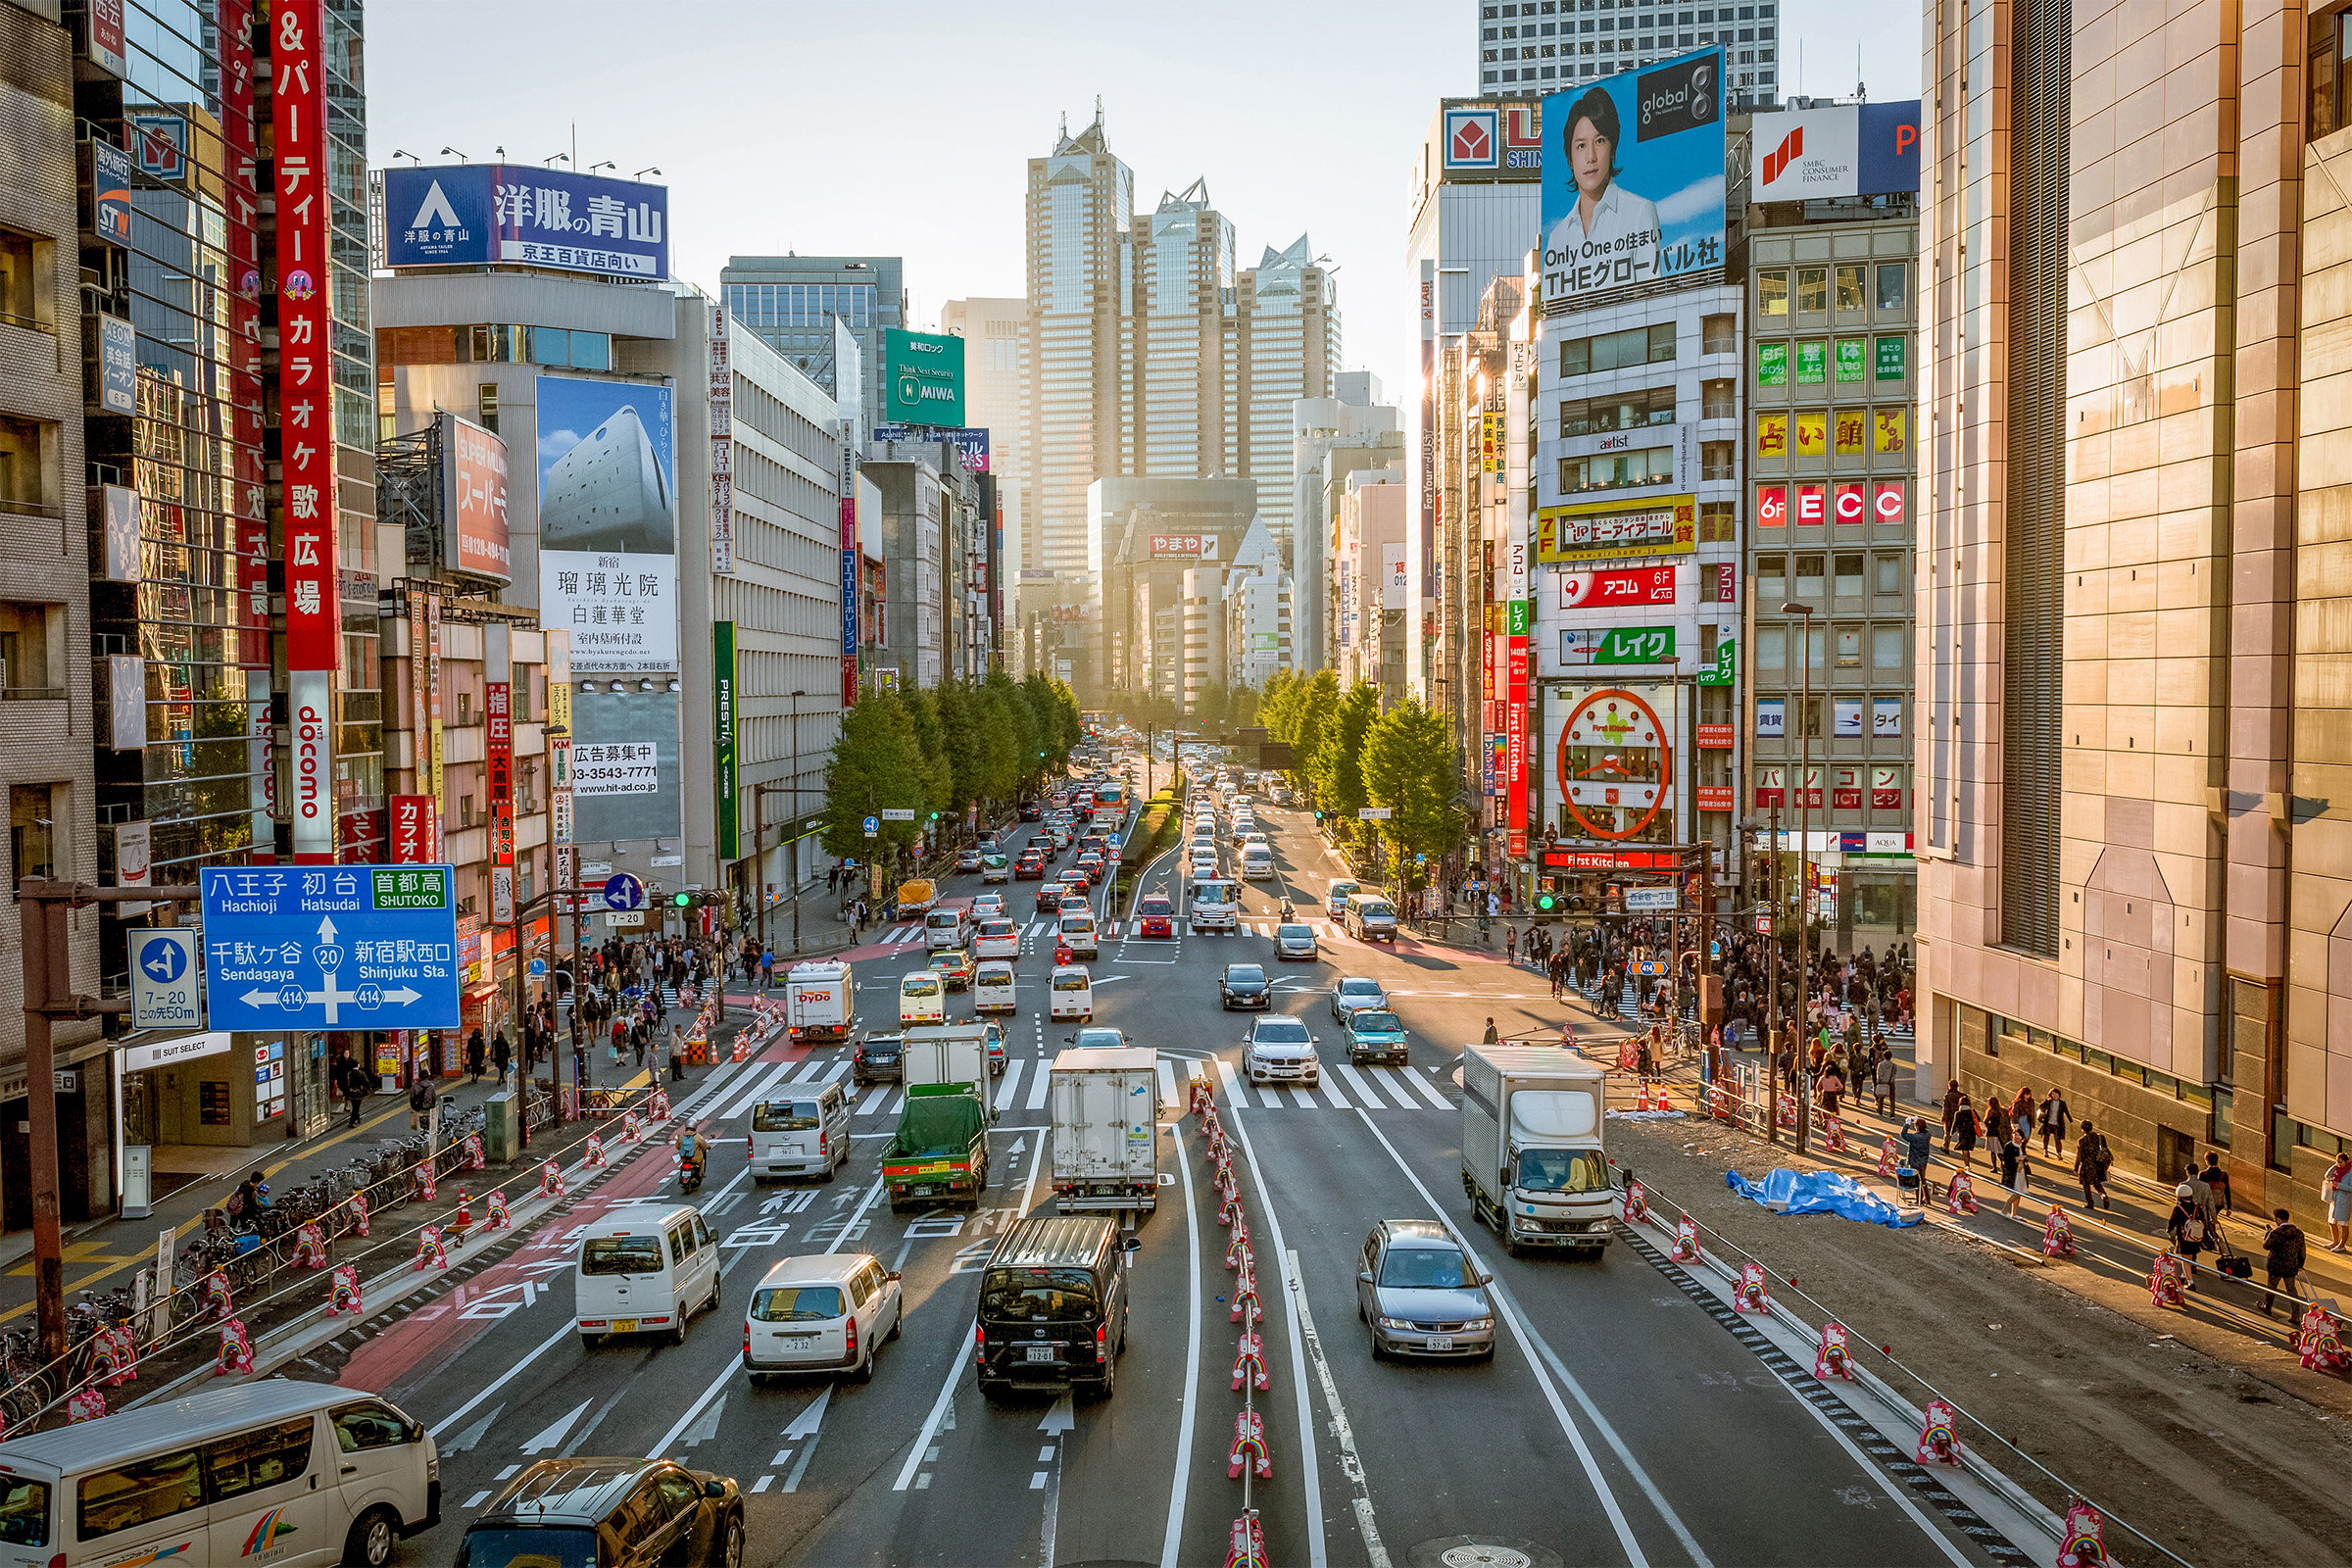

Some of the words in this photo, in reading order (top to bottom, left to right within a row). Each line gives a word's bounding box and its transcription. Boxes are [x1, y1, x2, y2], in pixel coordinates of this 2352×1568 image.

[104, 52, 115, 67] 8F
[1642, 84, 1689, 125] global
[97, 146, 128, 174] 海外旅行
[1802, 159, 1826, 168] SMBC
[1802, 166, 1849, 175] CONSUMER
[1802, 173, 1839, 182] FINANCE
[100, 203, 128, 235] STW
[494, 183, 662, 243] 洋服の青山
[405, 229, 469, 243] 洋服の青山
[1544, 246, 1578, 268] Only
[1581, 240, 1612, 260] One
[1614, 227, 1663, 252] の住まい
[522, 244, 638, 269] 京王百貨店向い
[1544, 236, 1719, 296] THEグローバル社
[1421, 282, 1430, 307] LABI
[105, 320, 131, 347] AEON
[909, 341, 944, 354] 美和ロック
[1762, 348, 1786, 361] 8F
[1881, 344, 1901, 353] 肩こり
[106, 345, 131, 369] 英会話
[1514, 343, 1524, 382] 村上ビル
[104, 366, 134, 389] イーオン
[899, 365, 916, 373] Think
[931, 368, 955, 379] Security
[1760, 366, 1786, 374] 60分
[921, 385, 956, 402] MIWA
[659, 389, 669, 464] 白き華、ひらく。
[1599, 434, 1629, 451] artist
[1760, 420, 1864, 451] 占い館
[290, 315, 320, 615] カラオケ歌広場
[1760, 496, 1786, 519] 6F
[1800, 493, 1903, 519] ECC
[1592, 520, 1674, 542] エーアイアール
[1675, 505, 1693, 543] 賃貸
[1153, 537, 1198, 551] やまや
[598, 556, 619, 568] 新宿
[1513, 544, 1524, 575] アコム
[1572, 547, 1657, 560] www.air-home.jp
[558, 571, 659, 597] 瑠璃光院
[1653, 570, 1670, 584] 6F
[1721, 566, 1732, 600] アコム
[1604, 579, 1639, 596] アコム
[573, 605, 645, 625] 白蓮華堂
[1513, 605, 1523, 631] レイク
[577, 632, 642, 645] 室内墓所付設
[1614, 632, 1666, 658] レイク
[1510, 648, 1527, 657] 140席
[637, 662, 670, 670] 2本目右折
[1721, 648, 1732, 679] レイク
[489, 692, 509, 738] 指圧
[1510, 703, 1520, 731] First
[1759, 714, 1783, 726] 賃貸
[553, 741, 570, 750] KM
[574, 745, 652, 762] 広告募集中
[298, 706, 321, 818] docomo
[1510, 734, 1520, 781] Kitchen
[580, 782, 657, 794] www.hit-ad.co.jp
[1606, 792, 1616, 802] FK
[1836, 793, 1861, 805] ICT
[1568, 855, 1590, 865] First
[210, 873, 287, 897] 八王子
[302, 872, 358, 897] 初台
[375, 872, 441, 893] 首都高
[221, 899, 277, 914] Hachioji
[301, 898, 360, 911] Hatsudai
[379, 895, 439, 906] SHUTOKO
[319, 950, 338, 964] 20
[355, 939, 450, 963] 新宿駅西口
[220, 968, 295, 982] Sendagaya
[359, 965, 417, 980] Shinjuku
[422, 965, 448, 977] Sta.
[282, 991, 303, 1004] 414
[359, 990, 379, 1003] 414
[799, 994, 831, 1004] DyDo
[139, 1006, 195, 1020] この先50m
[163, 1047, 182, 1057] SUIT
[183, 1042, 207, 1054] SELECT
